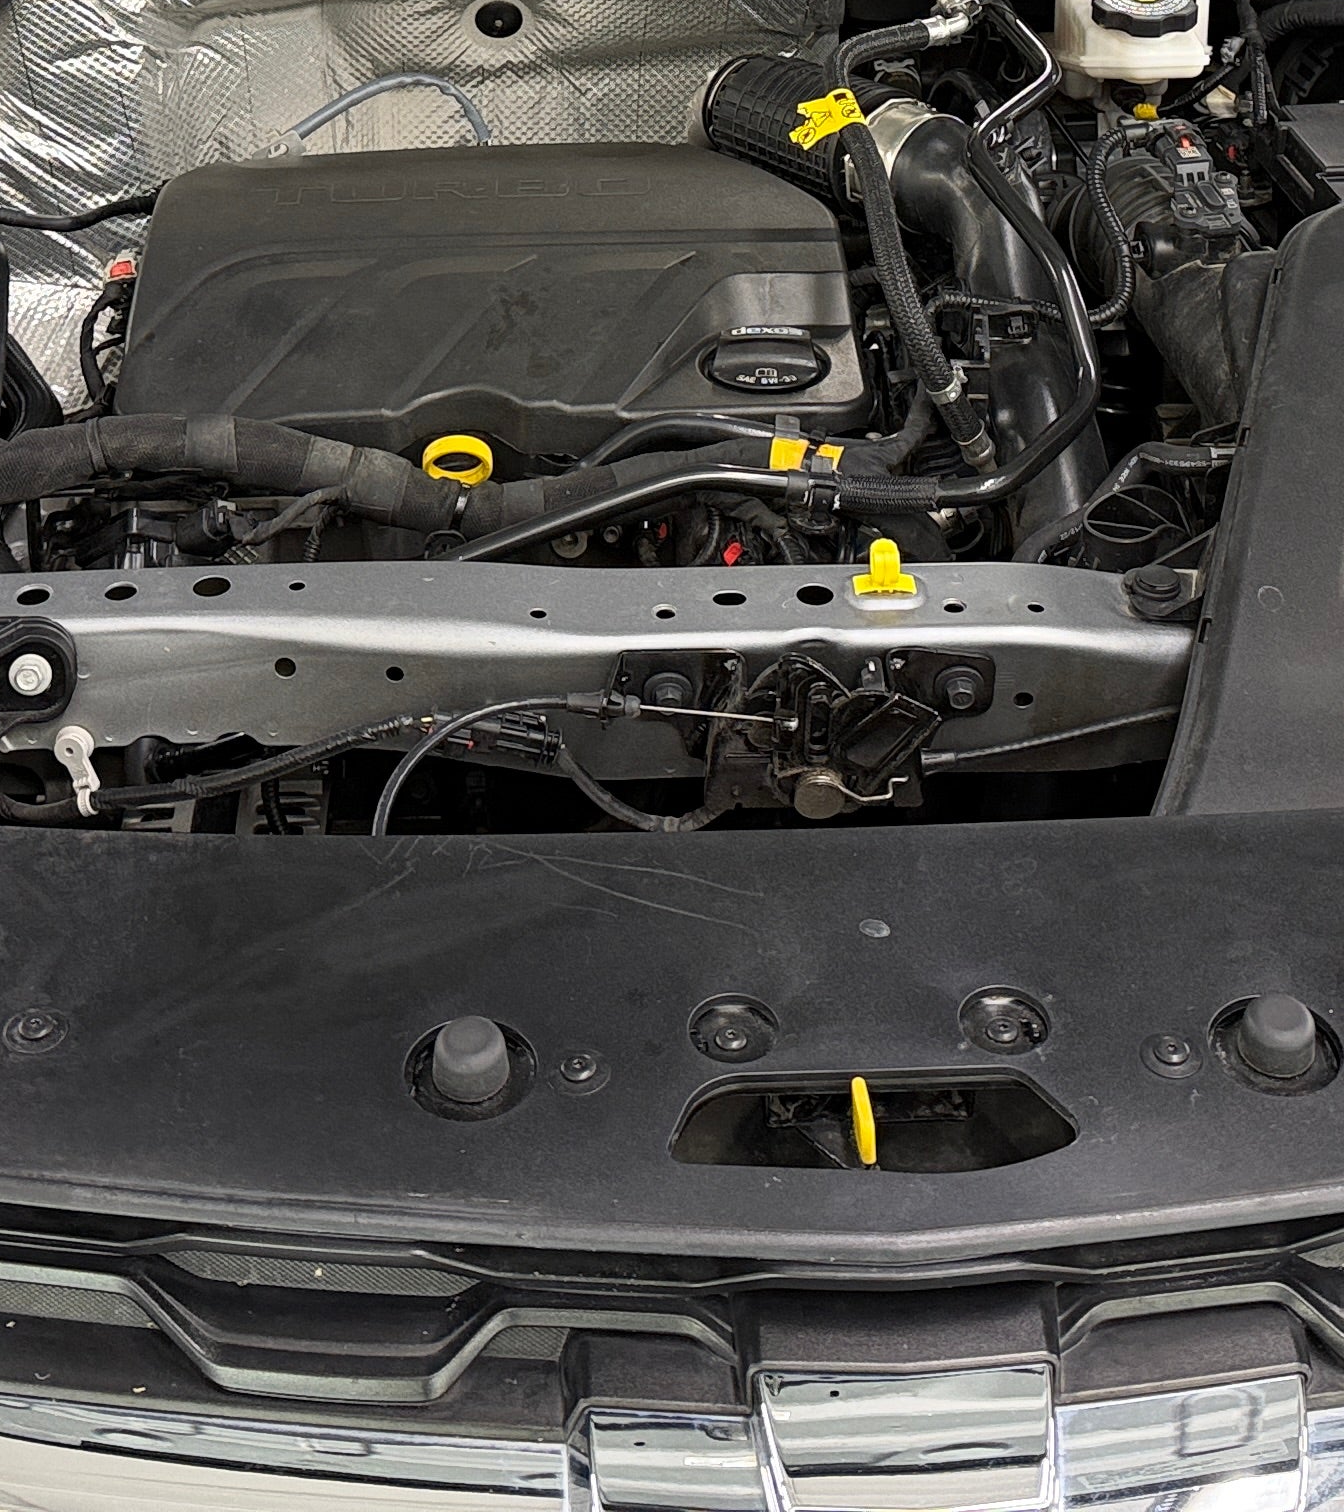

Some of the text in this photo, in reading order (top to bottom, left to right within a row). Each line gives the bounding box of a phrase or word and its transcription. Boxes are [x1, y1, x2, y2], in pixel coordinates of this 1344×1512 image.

[256, 175, 652, 206] TURBO
[731, 326, 803, 336] dexos
[735, 374, 757, 384] SAE
